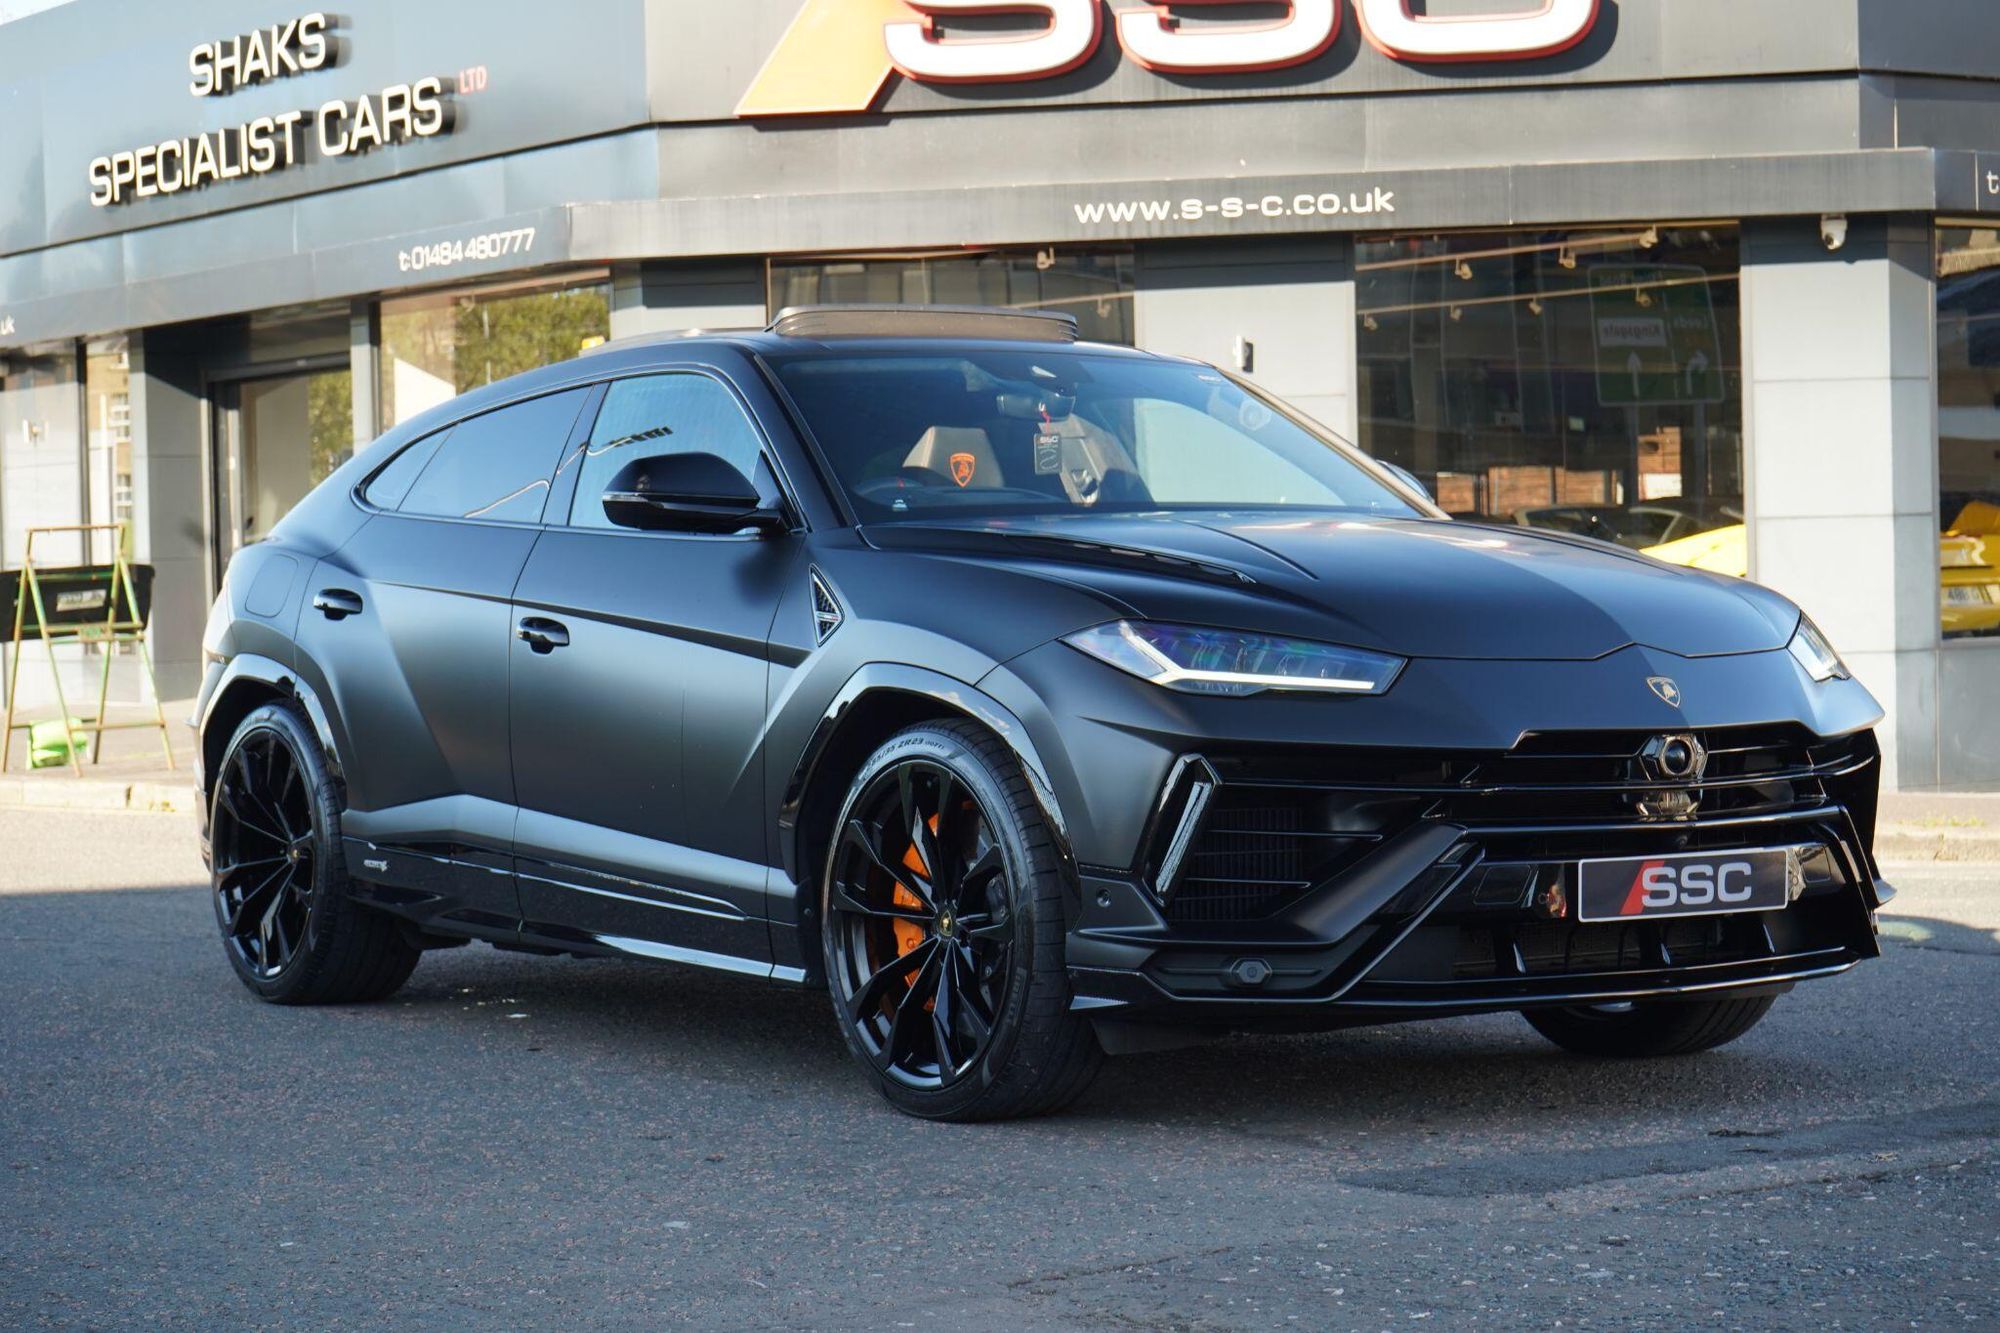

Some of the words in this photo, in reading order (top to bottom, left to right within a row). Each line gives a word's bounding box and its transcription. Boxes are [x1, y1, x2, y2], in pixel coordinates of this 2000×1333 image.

[188, 12, 326, 97] SHAKS
[89, 110, 301, 206] SPECIALIST
[318, 77, 443, 156] CARS
[459, 66, 488, 94] LTD
[1074, 187, 1395, 223] www.s-s-c.co.uk
[464, 227, 535, 260] 480777
[1641, 862, 1752, 907] SSC
